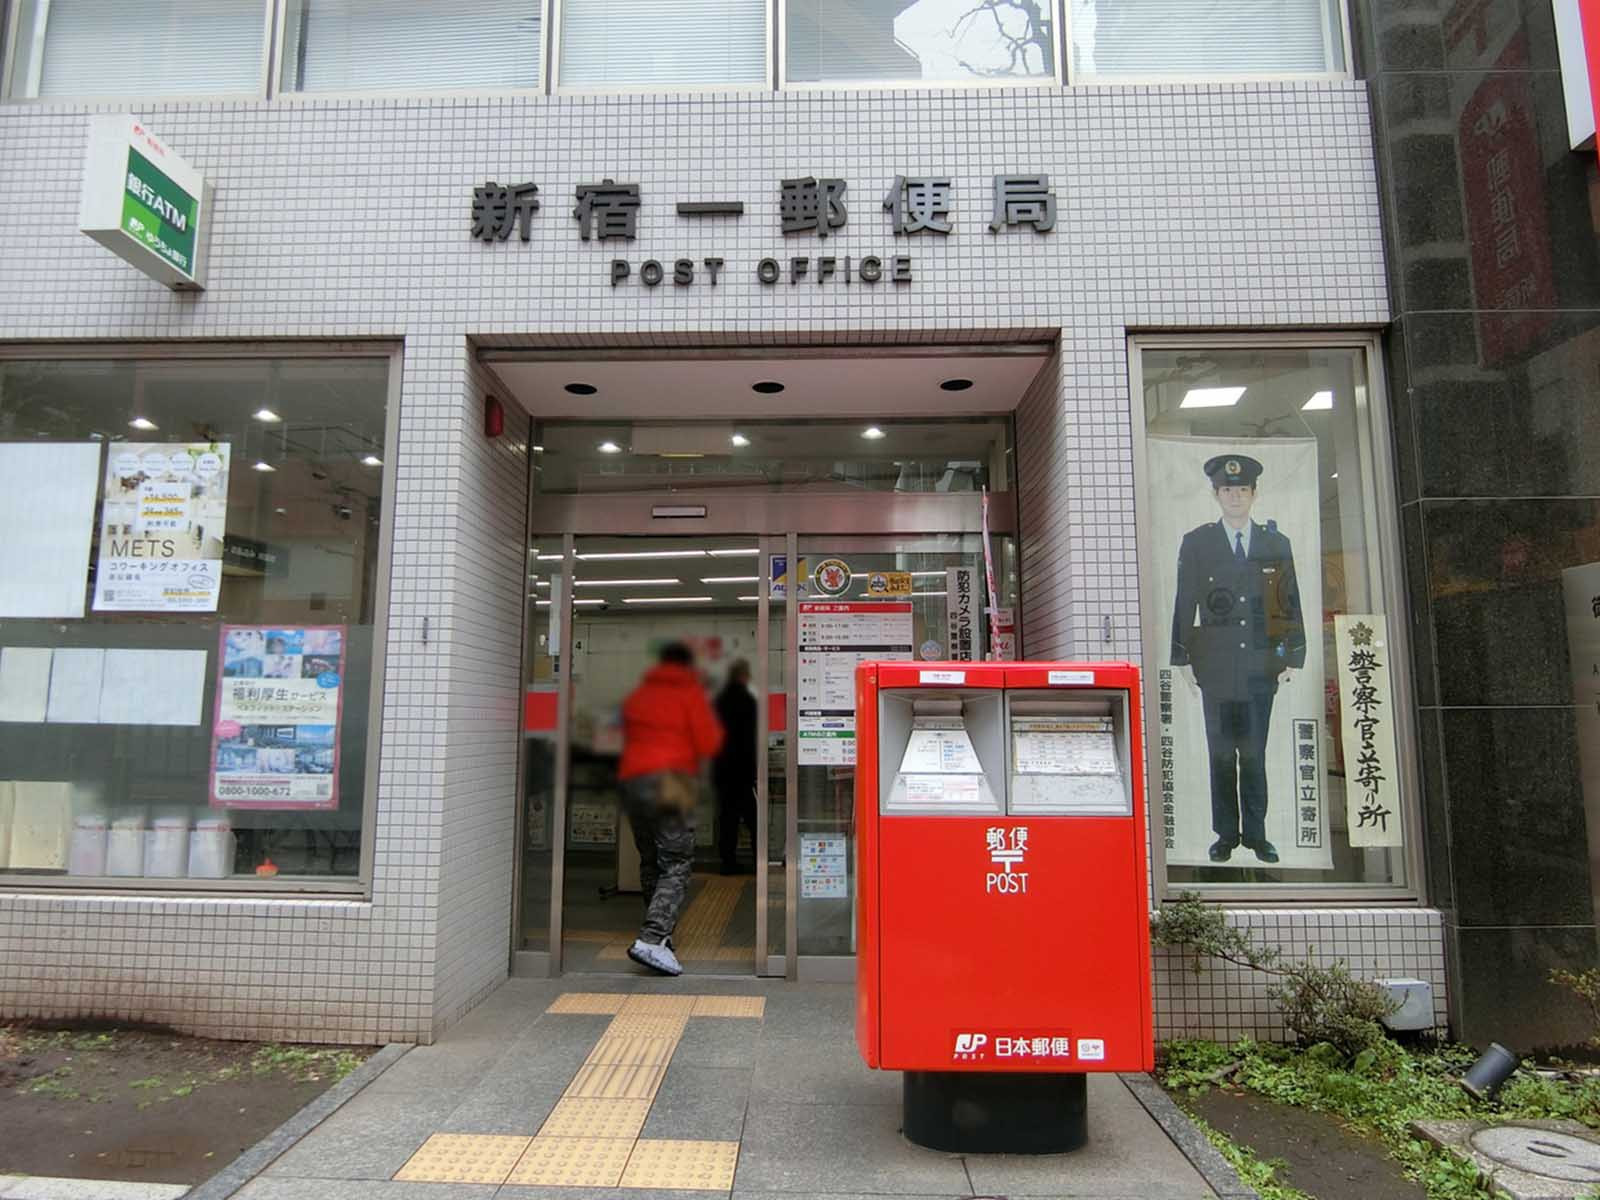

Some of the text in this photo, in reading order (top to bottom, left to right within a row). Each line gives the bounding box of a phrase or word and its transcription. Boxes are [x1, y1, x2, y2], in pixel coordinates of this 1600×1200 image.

[470, 174, 1057, 243] 新宿一郵便局
[611, 255, 913, 287] POST OFFICE
[111, 539, 176, 558] METS
[1348, 650, 1392, 832] 警察官立寄り所
[1298, 722, 1318, 843] 警察官立寄所
[986, 827, 1029, 851] 郵便
[986, 873, 1029, 894] POST
[995, 1037, 1070, 1057] 日本郵便
